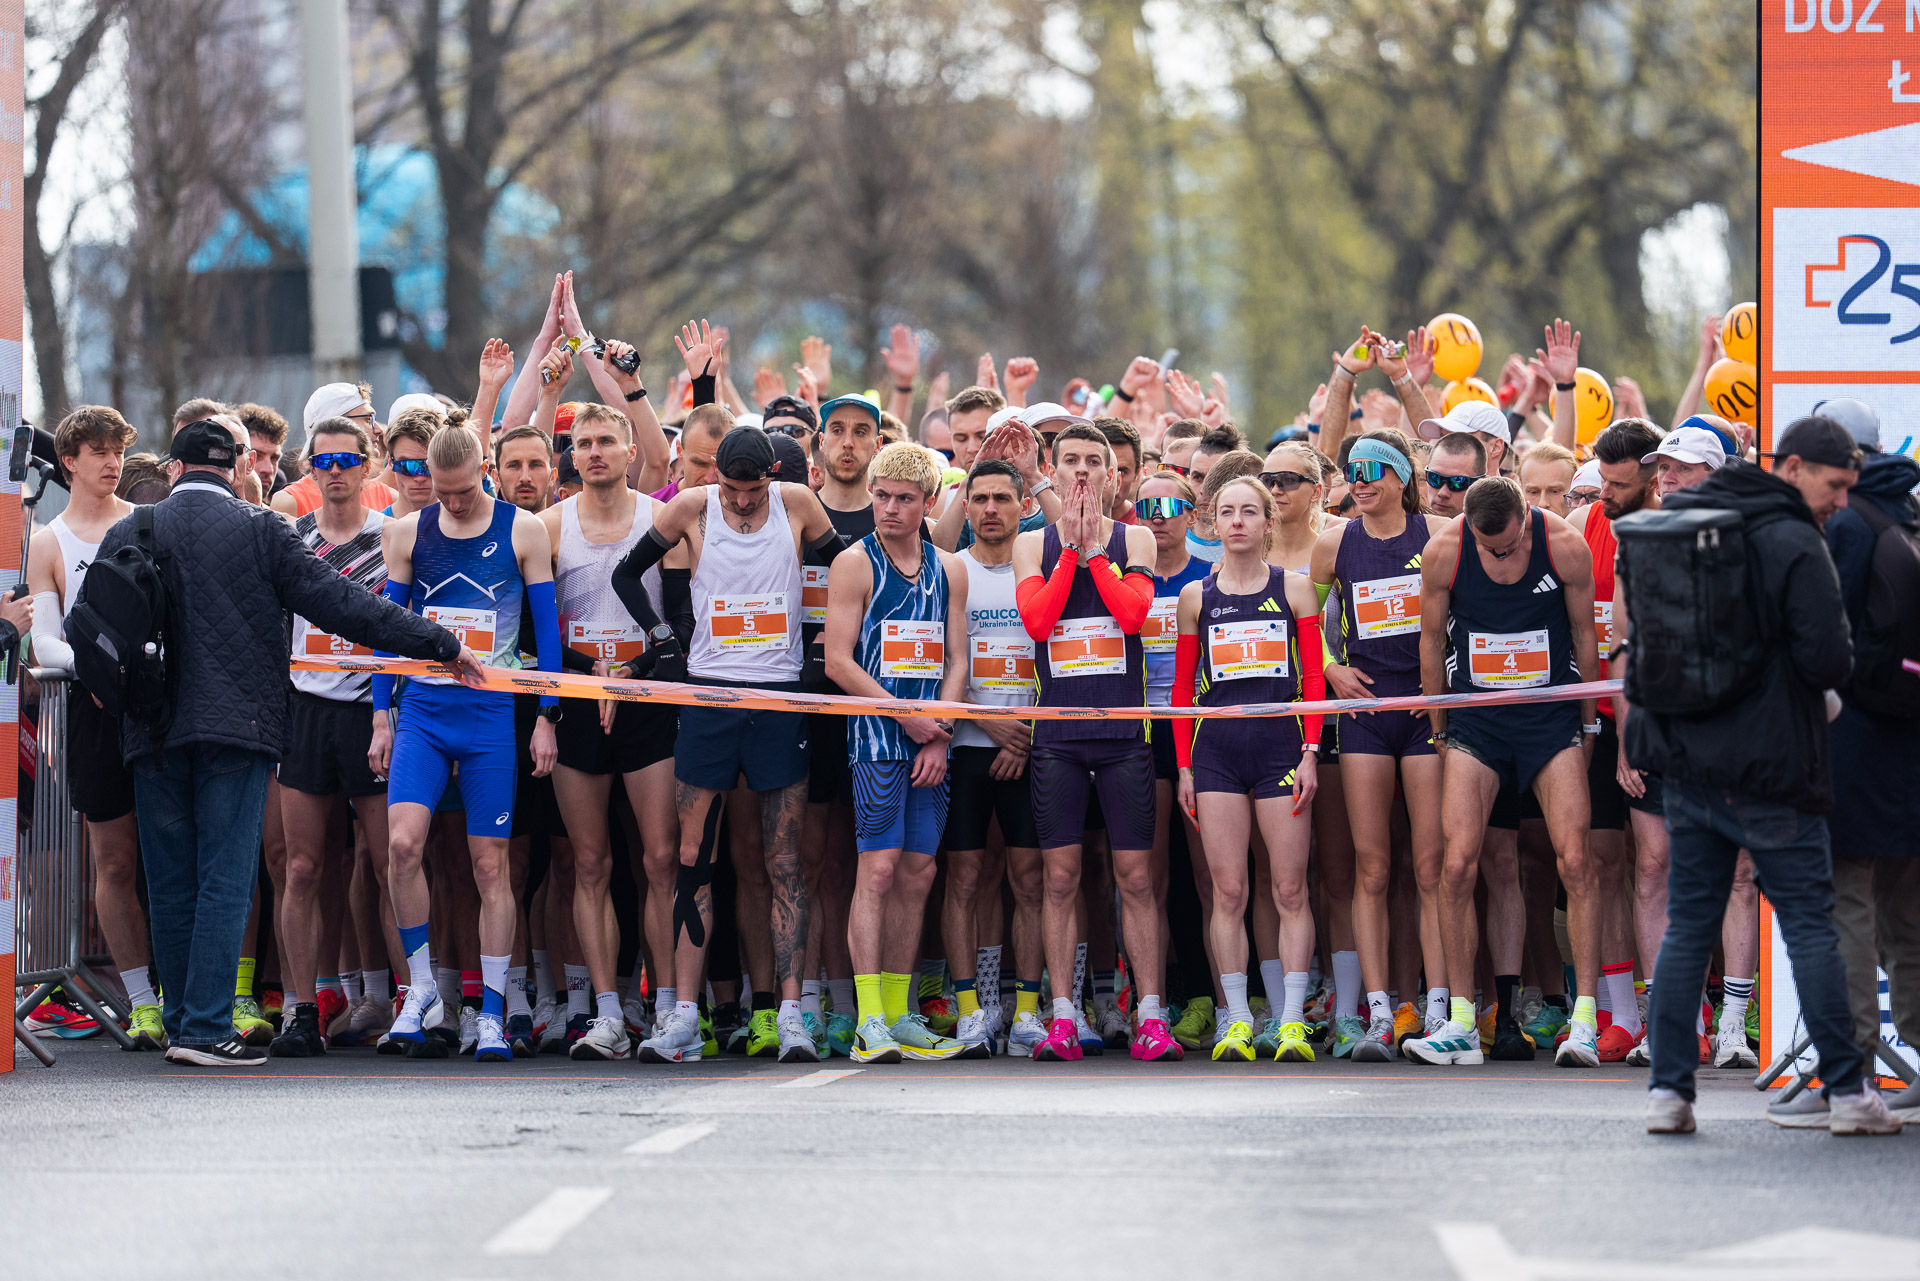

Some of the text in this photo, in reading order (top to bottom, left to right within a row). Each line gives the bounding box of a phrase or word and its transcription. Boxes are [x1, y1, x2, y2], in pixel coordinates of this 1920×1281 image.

[1784, 0, 1884, 33] DOZ
[1371, 444, 1406, 472] RUNNING
[971, 608, 1022, 621] sauco
[1383, 598, 1405, 615] 12
[743, 615, 755, 631] 5
[1158, 617, 1178, 632] 13
[330, 634, 354, 651] 25
[596, 643, 617, 658] 19
[914, 642, 924, 657] 8
[1083, 639, 1091, 654] 1
[1240, 642, 1257, 658] 11
[1004, 658, 1016, 674] 9
[1503, 653, 1518, 669] 4
